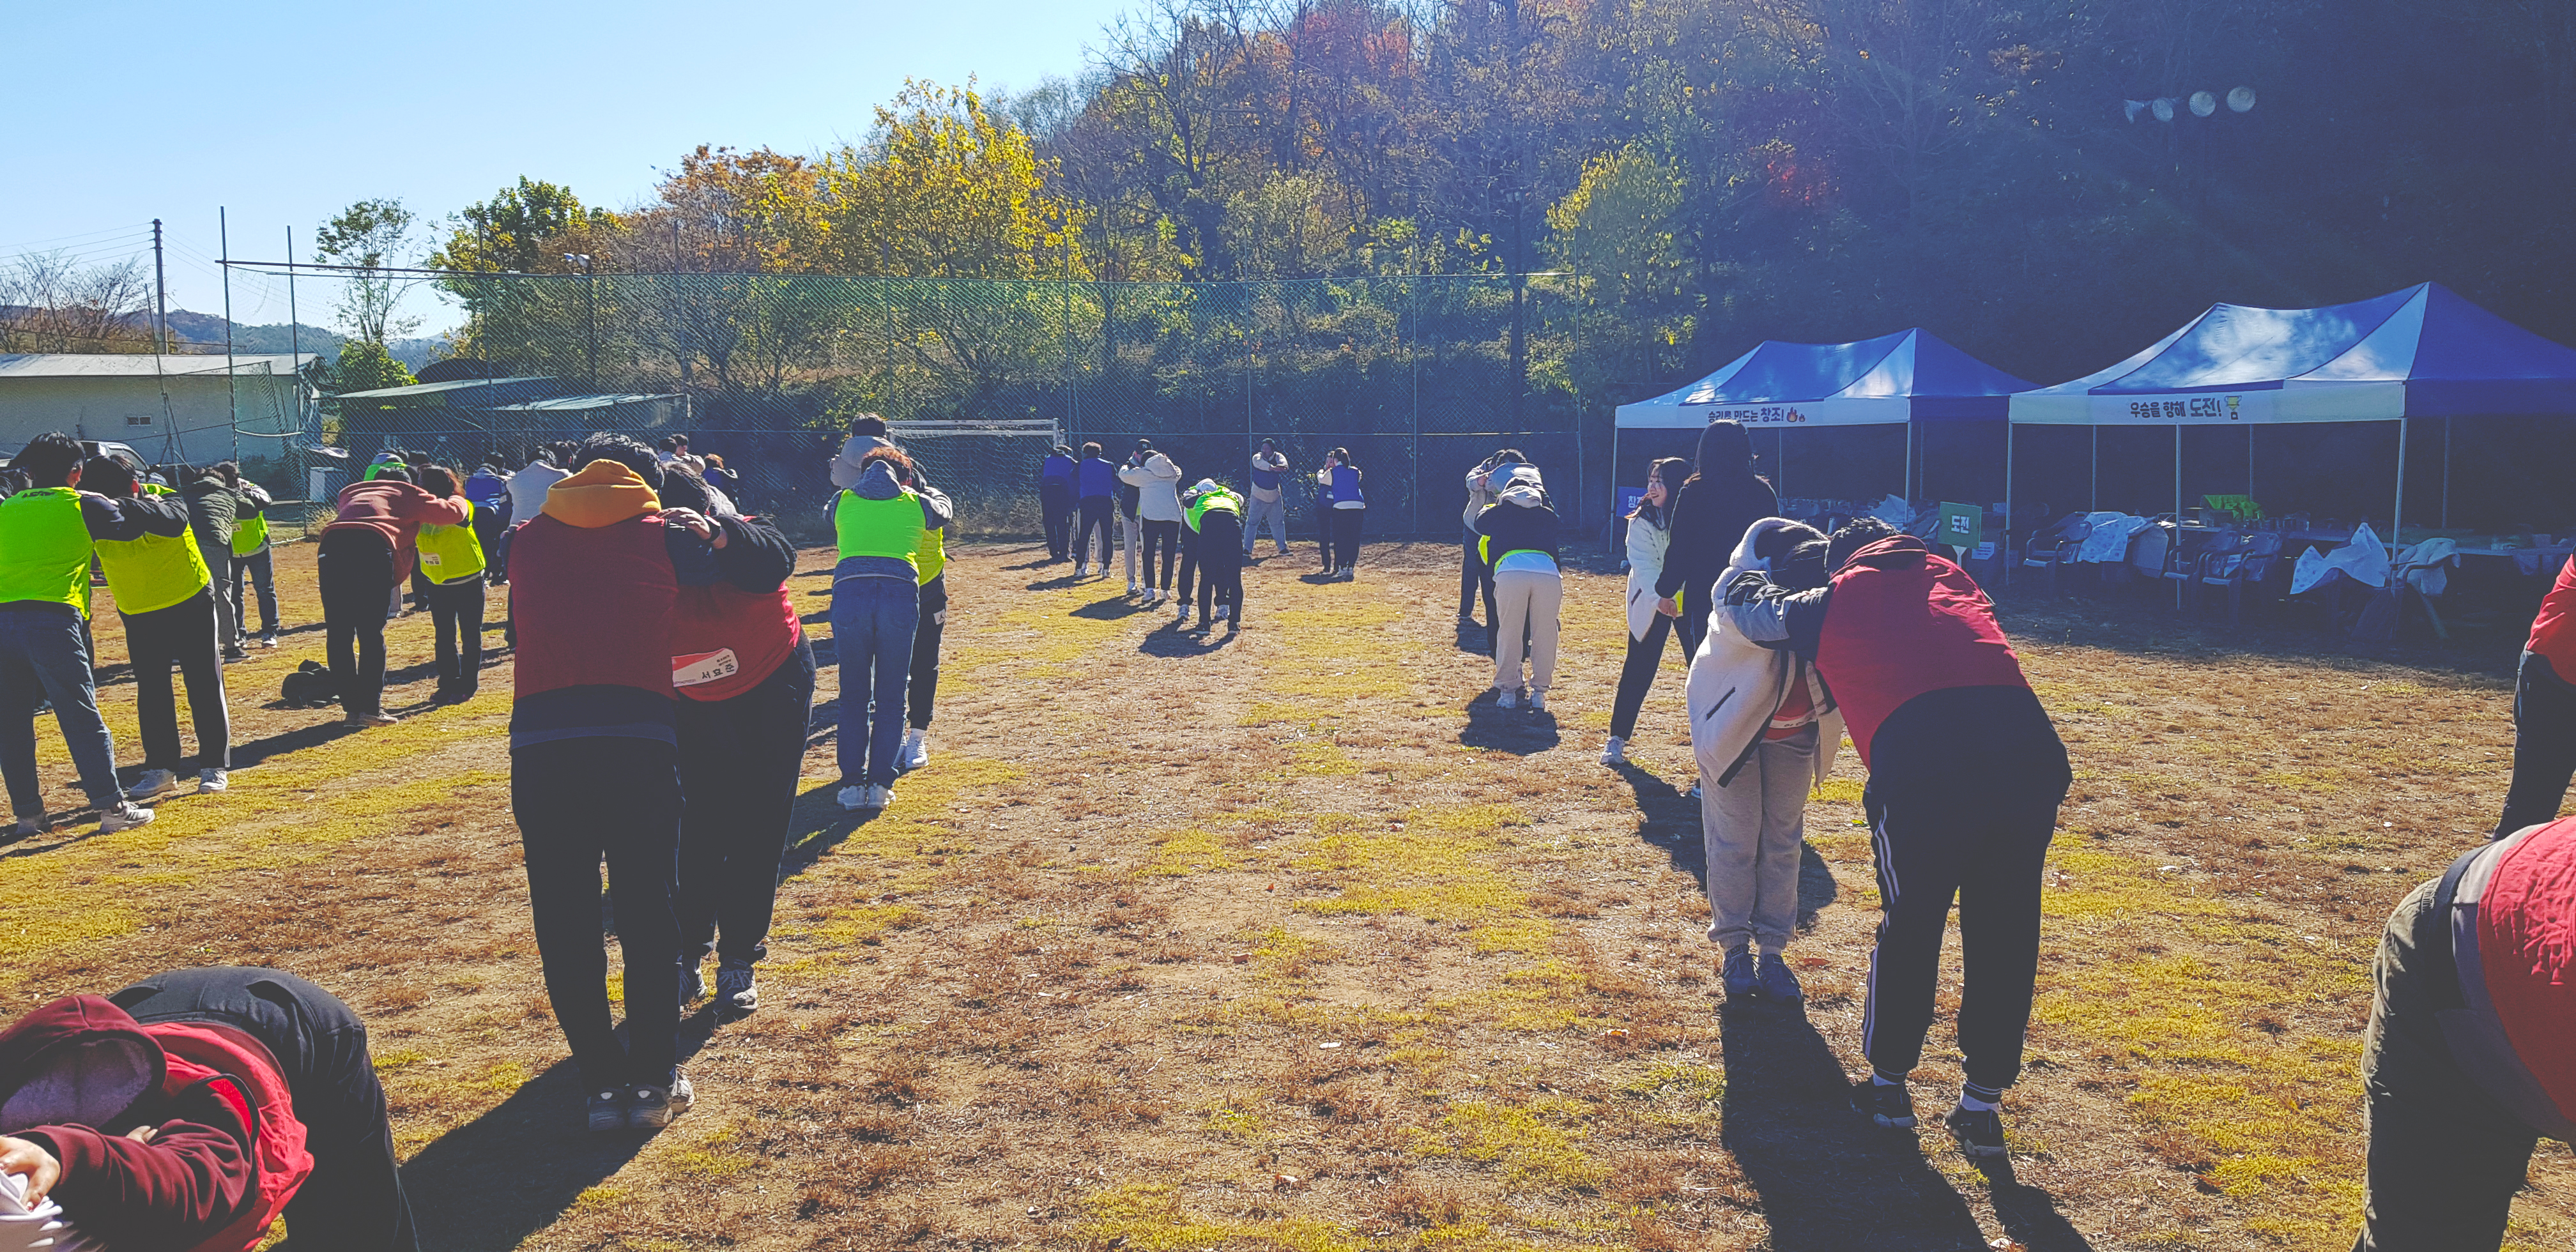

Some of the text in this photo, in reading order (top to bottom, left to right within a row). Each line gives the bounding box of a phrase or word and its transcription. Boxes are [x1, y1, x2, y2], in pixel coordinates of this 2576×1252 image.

[1761, 408, 1784, 422] 창조!
[2131, 398, 2222, 418] 우승을 향해 도전!
[1951, 515, 1970, 534] 도전
